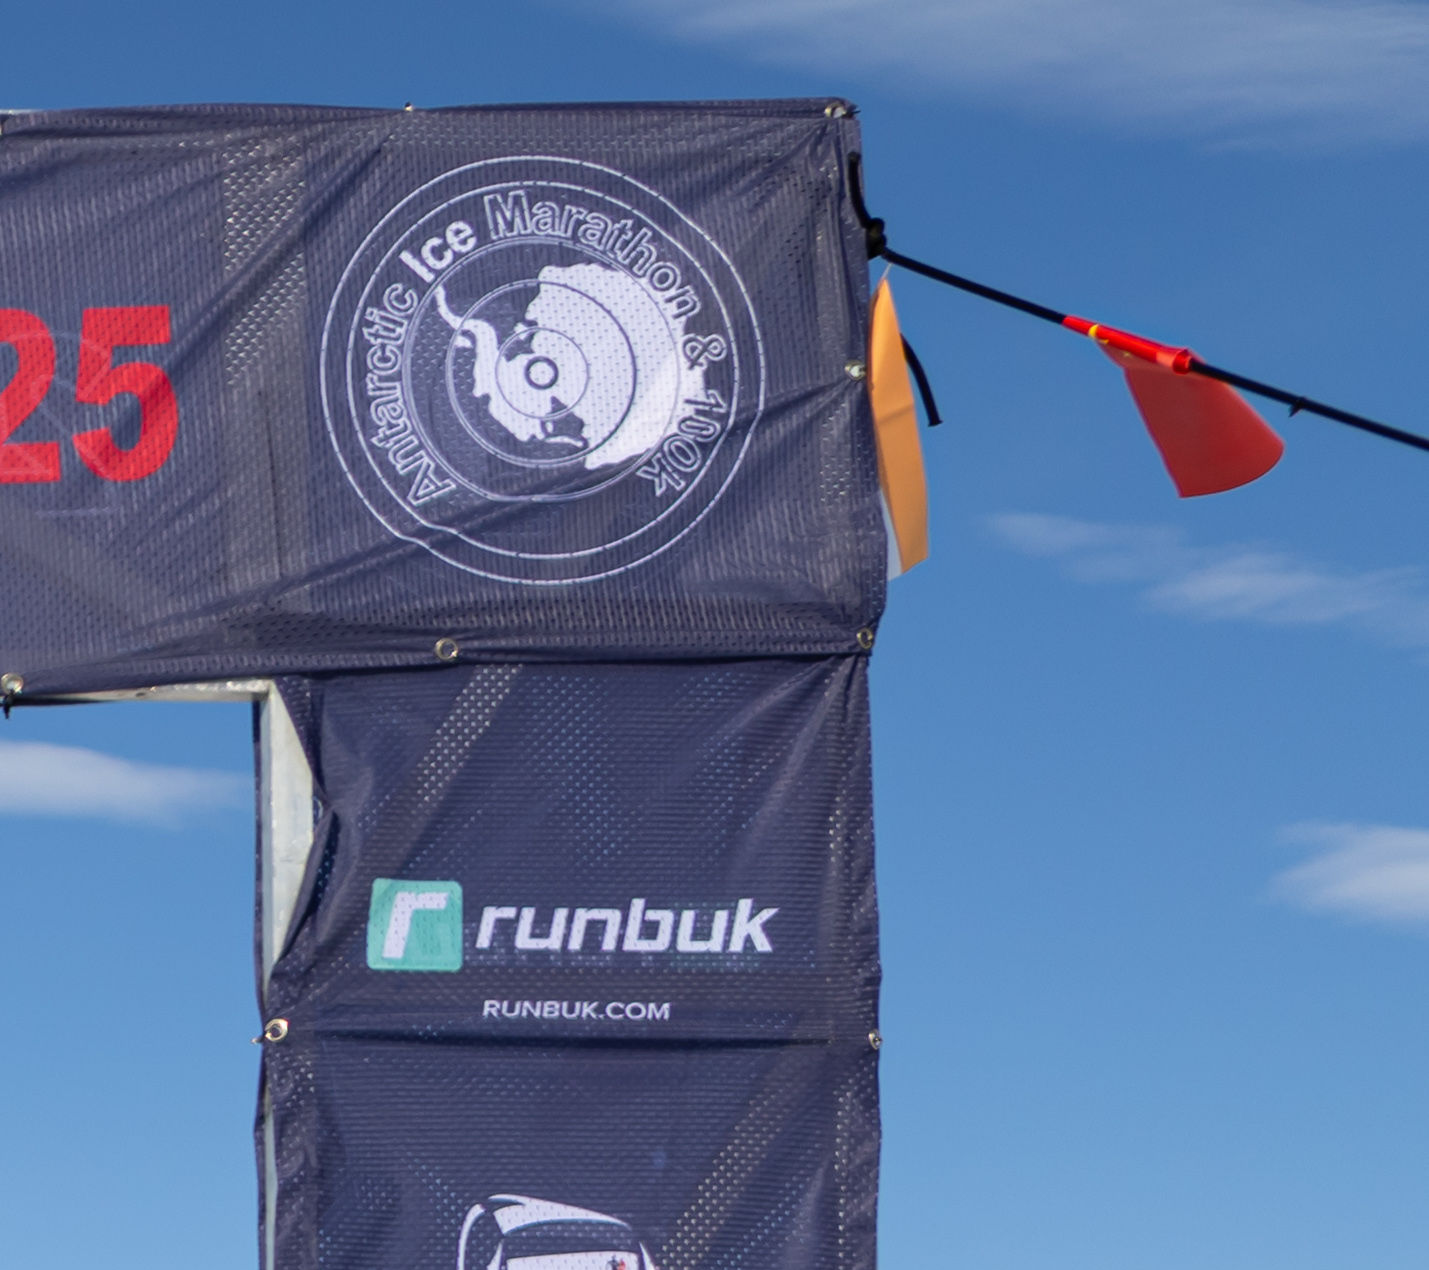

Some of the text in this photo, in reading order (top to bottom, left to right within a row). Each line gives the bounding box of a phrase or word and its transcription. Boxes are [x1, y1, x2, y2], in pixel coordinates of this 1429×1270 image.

[399, 220, 477, 283] Ice
[483, 190, 701, 320] Marathon
[683, 333, 726, 369] &
[362, 283, 455, 506] Antarctic
[475, 898, 779, 953] runbuk
[482, 999, 670, 1021] RUNBUK.COM
